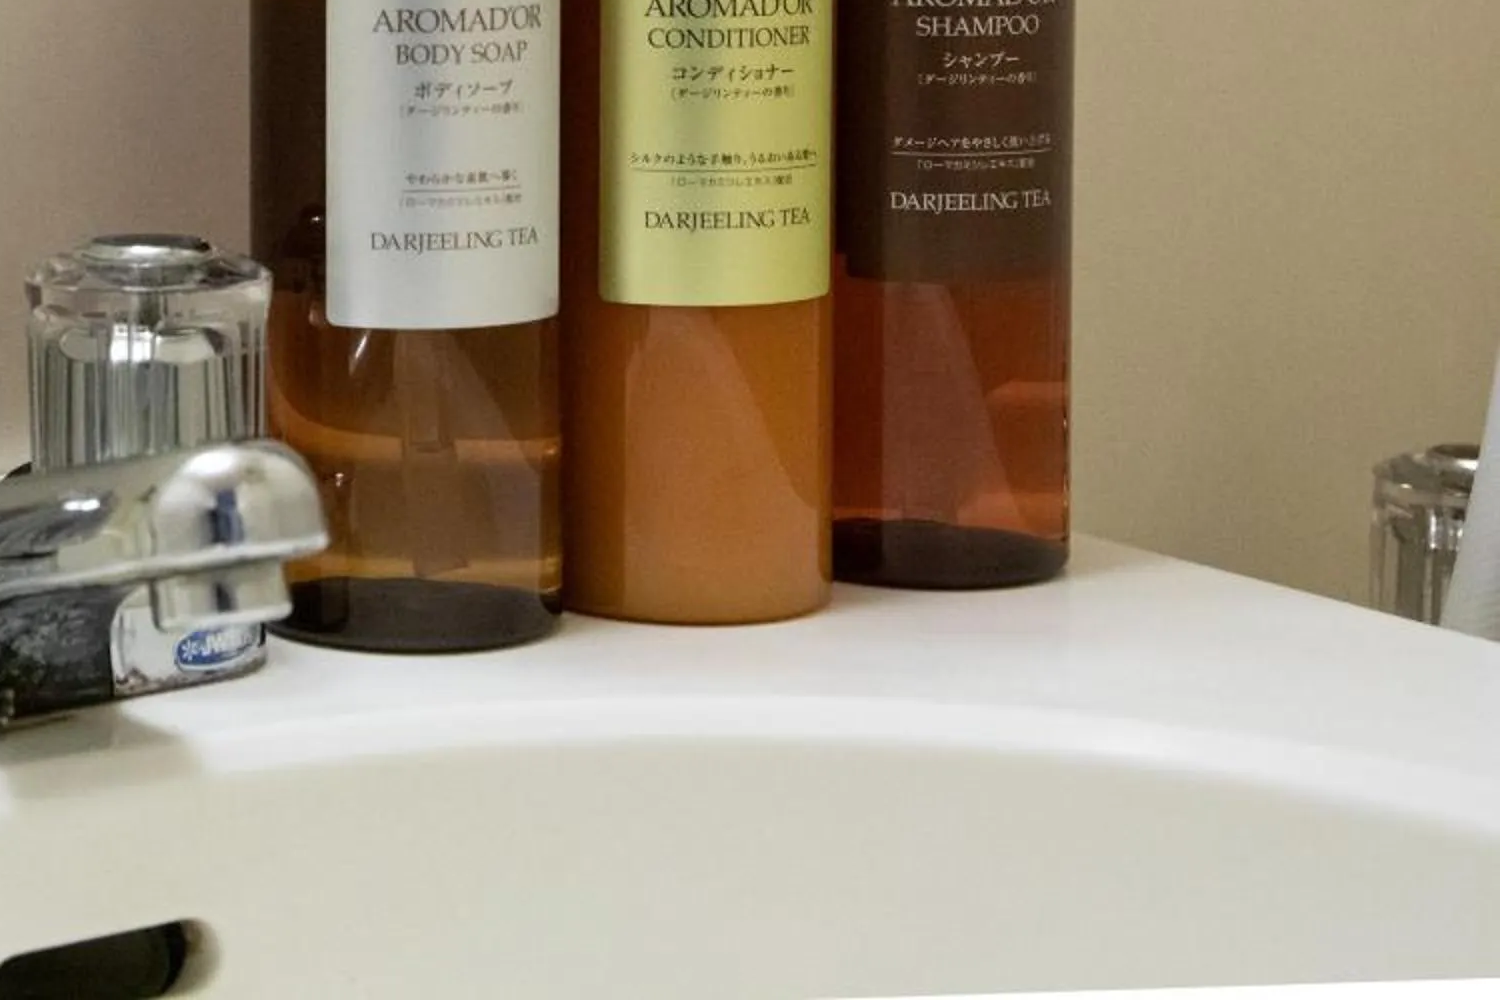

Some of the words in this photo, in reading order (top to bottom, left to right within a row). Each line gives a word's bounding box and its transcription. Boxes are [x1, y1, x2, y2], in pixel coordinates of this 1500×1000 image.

[372, 4, 542, 33] AROMAD'OR
[915, 14, 1040, 37] SHAMPOO
[648, 25, 810, 50] CONDITIONER
[396, 44, 466, 65] BODY
[470, 41, 529, 63] SOAP
[943, 52, 1020, 68] シャンプー
[672, 64, 795, 82] コンディショナー
[414, 79, 513, 99] ボディソープ
[890, 190, 1018, 213] DARJEELING
[1022, 189, 1051, 206] TEA
[644, 209, 775, 233] DARJEELING
[778, 207, 811, 226] TEA
[370, 230, 504, 255] DARJEELING
[507, 226, 540, 247] TEA
